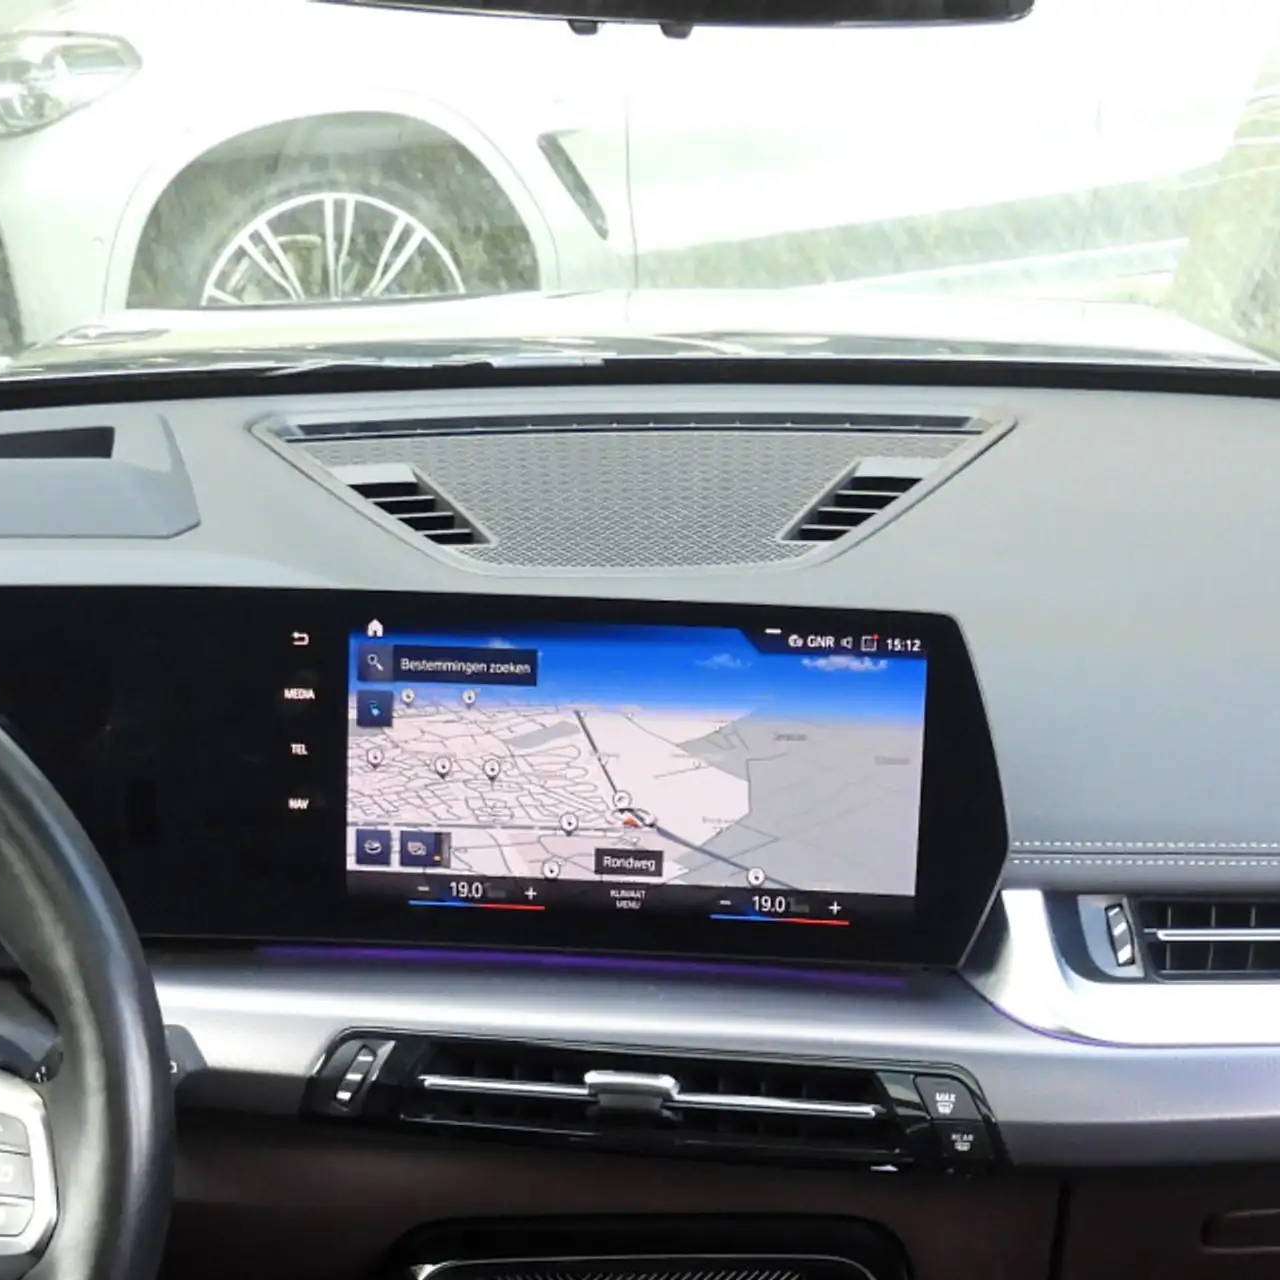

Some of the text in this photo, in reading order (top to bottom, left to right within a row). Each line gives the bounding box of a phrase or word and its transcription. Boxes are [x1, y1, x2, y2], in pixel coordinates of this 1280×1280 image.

[807, 635, 835, 648] GNR
[886, 638, 922, 651] 15:12
[400, 657, 532, 675] Bestemmingen zoeken
[284, 688, 316, 700] MEDIA
[291, 743, 308, 755] TEL
[288, 798, 309, 809] NAV
[602, 855, 656, 872] Rondweg
[449, 882, 483, 898] 19.0
[752, 895, 786, 913] 19.0
